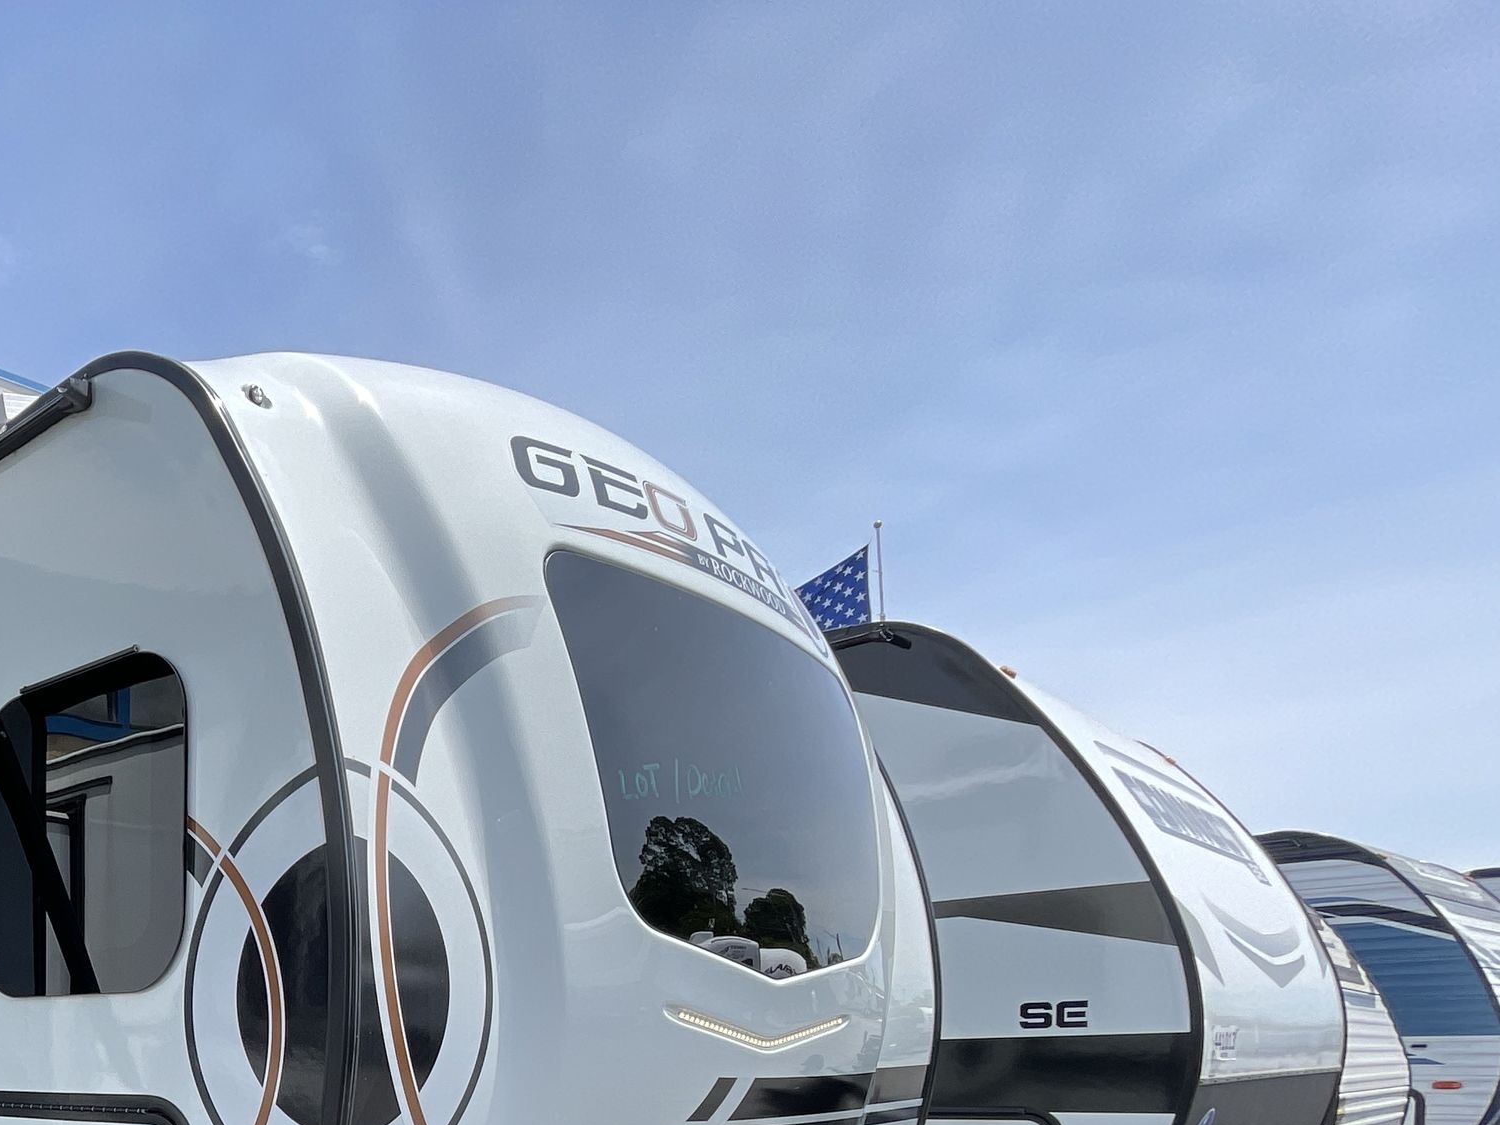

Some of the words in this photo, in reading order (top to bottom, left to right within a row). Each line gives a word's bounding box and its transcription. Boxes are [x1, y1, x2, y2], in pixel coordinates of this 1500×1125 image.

[510, 435, 697, 541] GEO
[697, 554, 710, 568] BY
[710, 558, 786, 615] ROCKWOOD
[618, 763, 660, 800] LOT
[1019, 1000, 1088, 1029] SE
